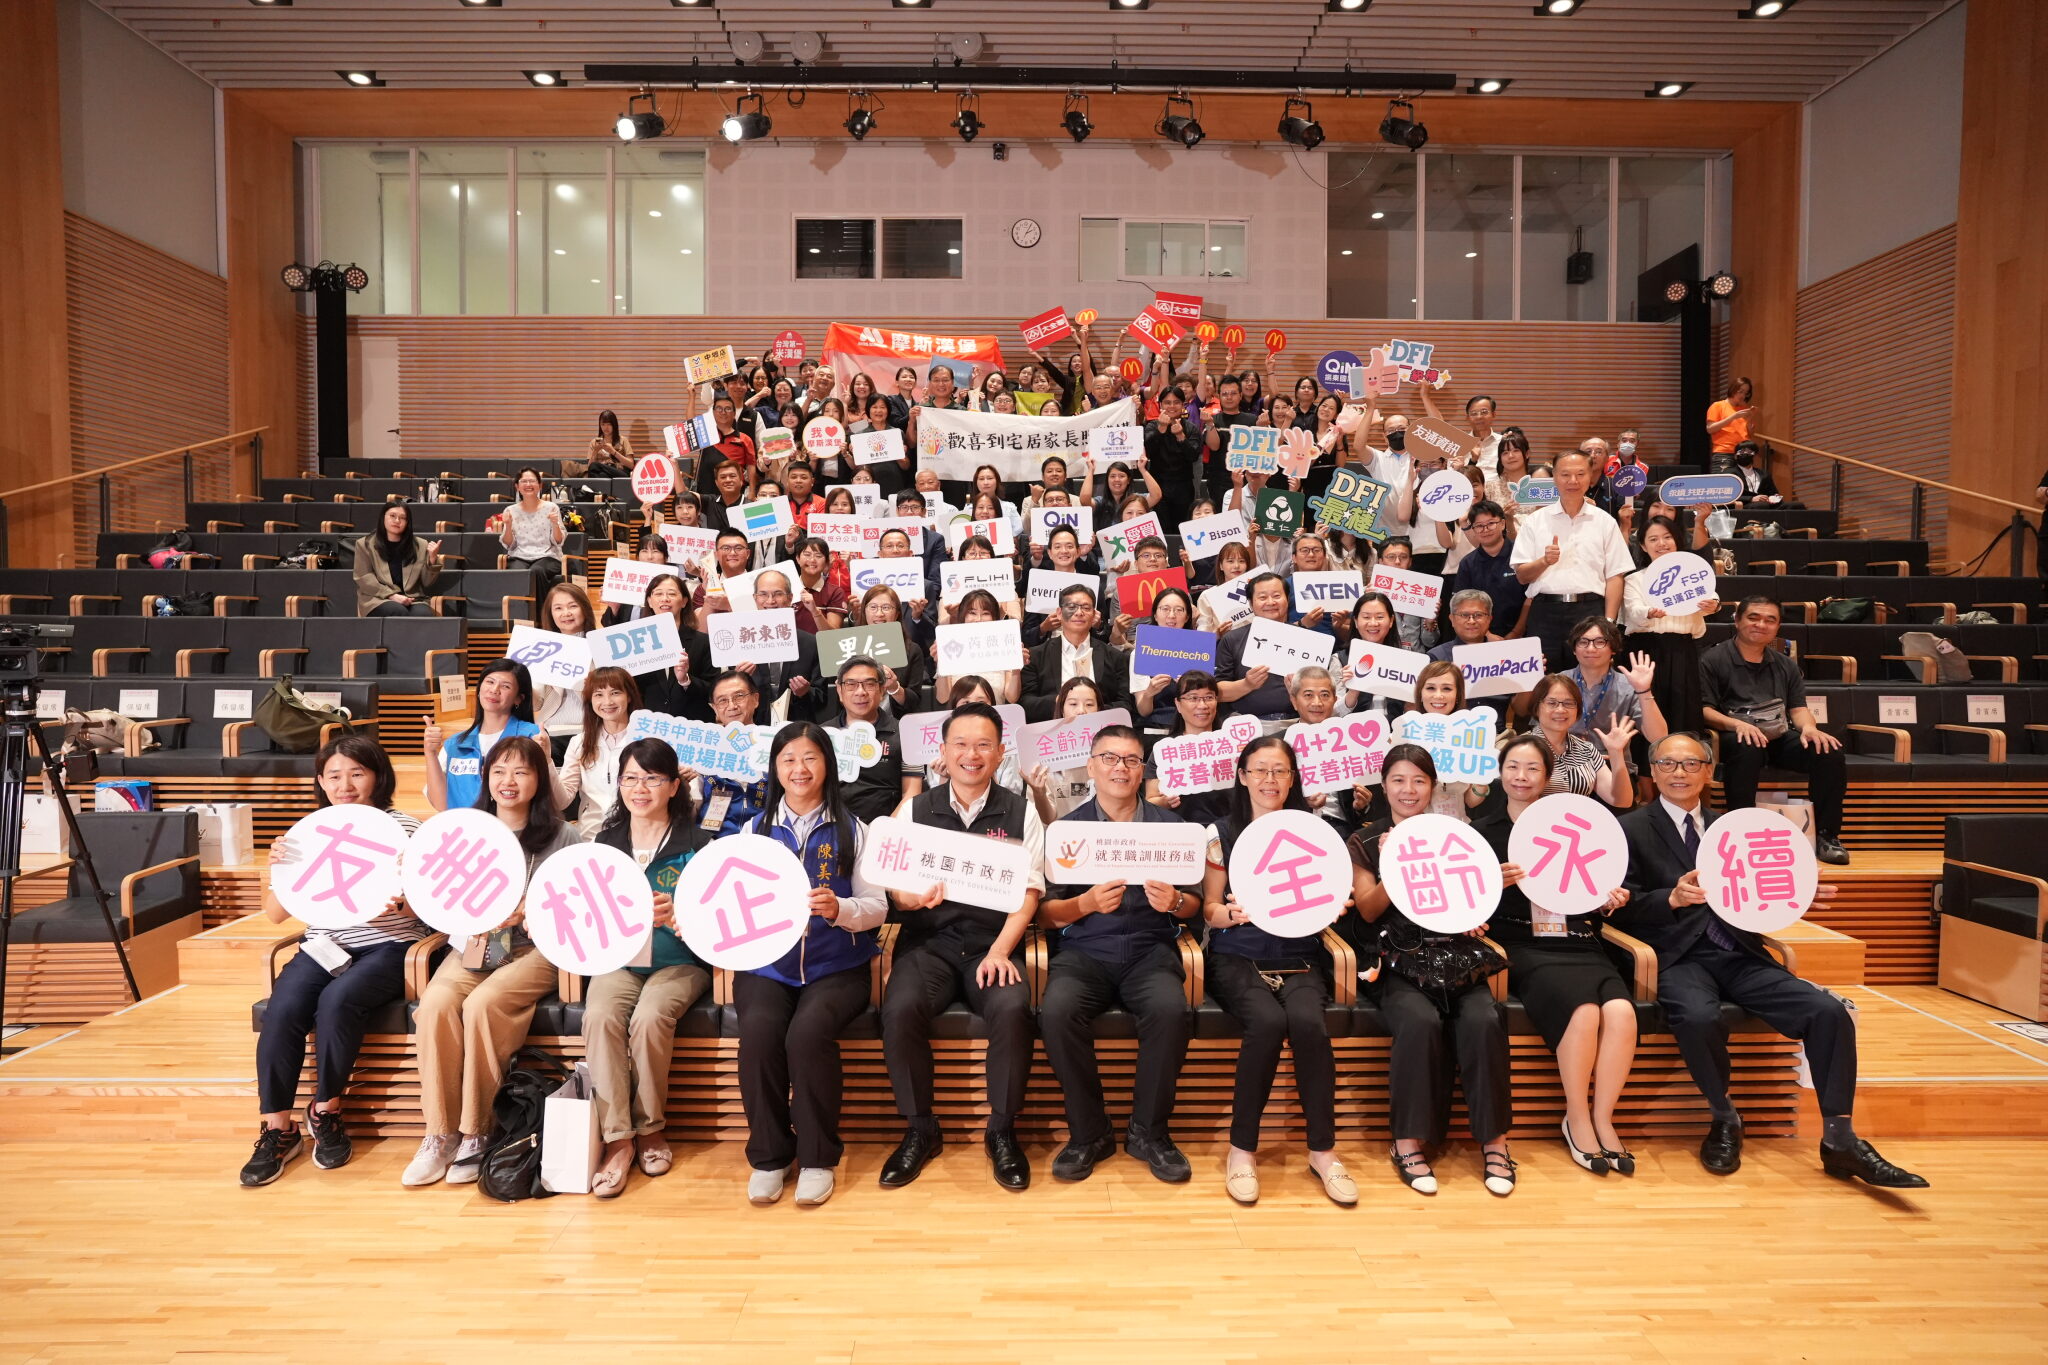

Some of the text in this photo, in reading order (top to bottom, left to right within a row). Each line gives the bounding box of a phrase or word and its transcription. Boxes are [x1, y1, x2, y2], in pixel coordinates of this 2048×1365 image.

[1172, 306, 1198, 316] 大全聯
[1041, 318, 1066, 333] 大全聯
[775, 340, 803, 348] 台灣第一
[775, 348, 803, 360] 米漢堡
[891, 333, 977, 353] 摩斯漢堡
[1390, 341, 1433, 366] DFI
[807, 439, 842, 448] 摩斯漢堡
[811, 428, 823, 438] 我
[1232, 428, 1277, 453] DFI
[1412, 424, 1461, 456] 友通資訊
[1230, 454, 1275, 470] 很可以
[638, 486, 669, 495] 摩斯漢堡
[1330, 471, 1388, 509] DFI
[1448, 494, 1470, 503] FSP
[1043, 511, 1079, 527] QiN
[1264, 522, 1291, 532] 里仁
[1319, 497, 1380, 536] 最棒
[677, 535, 717, 549] 摩斯漢堡
[749, 527, 779, 538] FamilyMart
[1209, 526, 1241, 541] Bison
[627, 573, 652, 585] 摩斯
[884, 573, 919, 586] GCE
[1395, 580, 1438, 599] 大全聯
[1681, 570, 1709, 586] FSP
[1300, 583, 1360, 600] ATEN
[1662, 586, 1708, 608] 全漢企業
[606, 624, 663, 660] DFI
[739, 624, 792, 643] 新東陽
[836, 635, 890, 666] 里仁
[550, 660, 585, 678] FSP
[1461, 656, 1540, 683] DynaPack
[636, 716, 721, 746] 支持中高齡
[1036, 722, 1117, 757] 全齡永
[1293, 728, 1348, 758] 4+2
[1402, 720, 1446, 743] 企業
[671, 743, 757, 777] 職場環境
[1161, 738, 1234, 764] 申請成為
[1429, 747, 1497, 777] 級UP
[1165, 757, 1239, 789] 友善標
[1299, 751, 1385, 787] 友善指標
[817, 843, 833, 888] 陳美
[1095, 849, 1196, 863] 就業職訓服務處
[1528, 812, 1608, 896] 永
[292, 823, 397, 914] 友
[418, 826, 509, 918] 善
[920, 851, 1015, 885] 桃園市政府
[1254, 829, 1335, 918] 全
[1397, 832, 1486, 915] 齡
[1717, 828, 1800, 912] 續
[542, 858, 644, 962] 桃
[699, 856, 794, 953] 企
